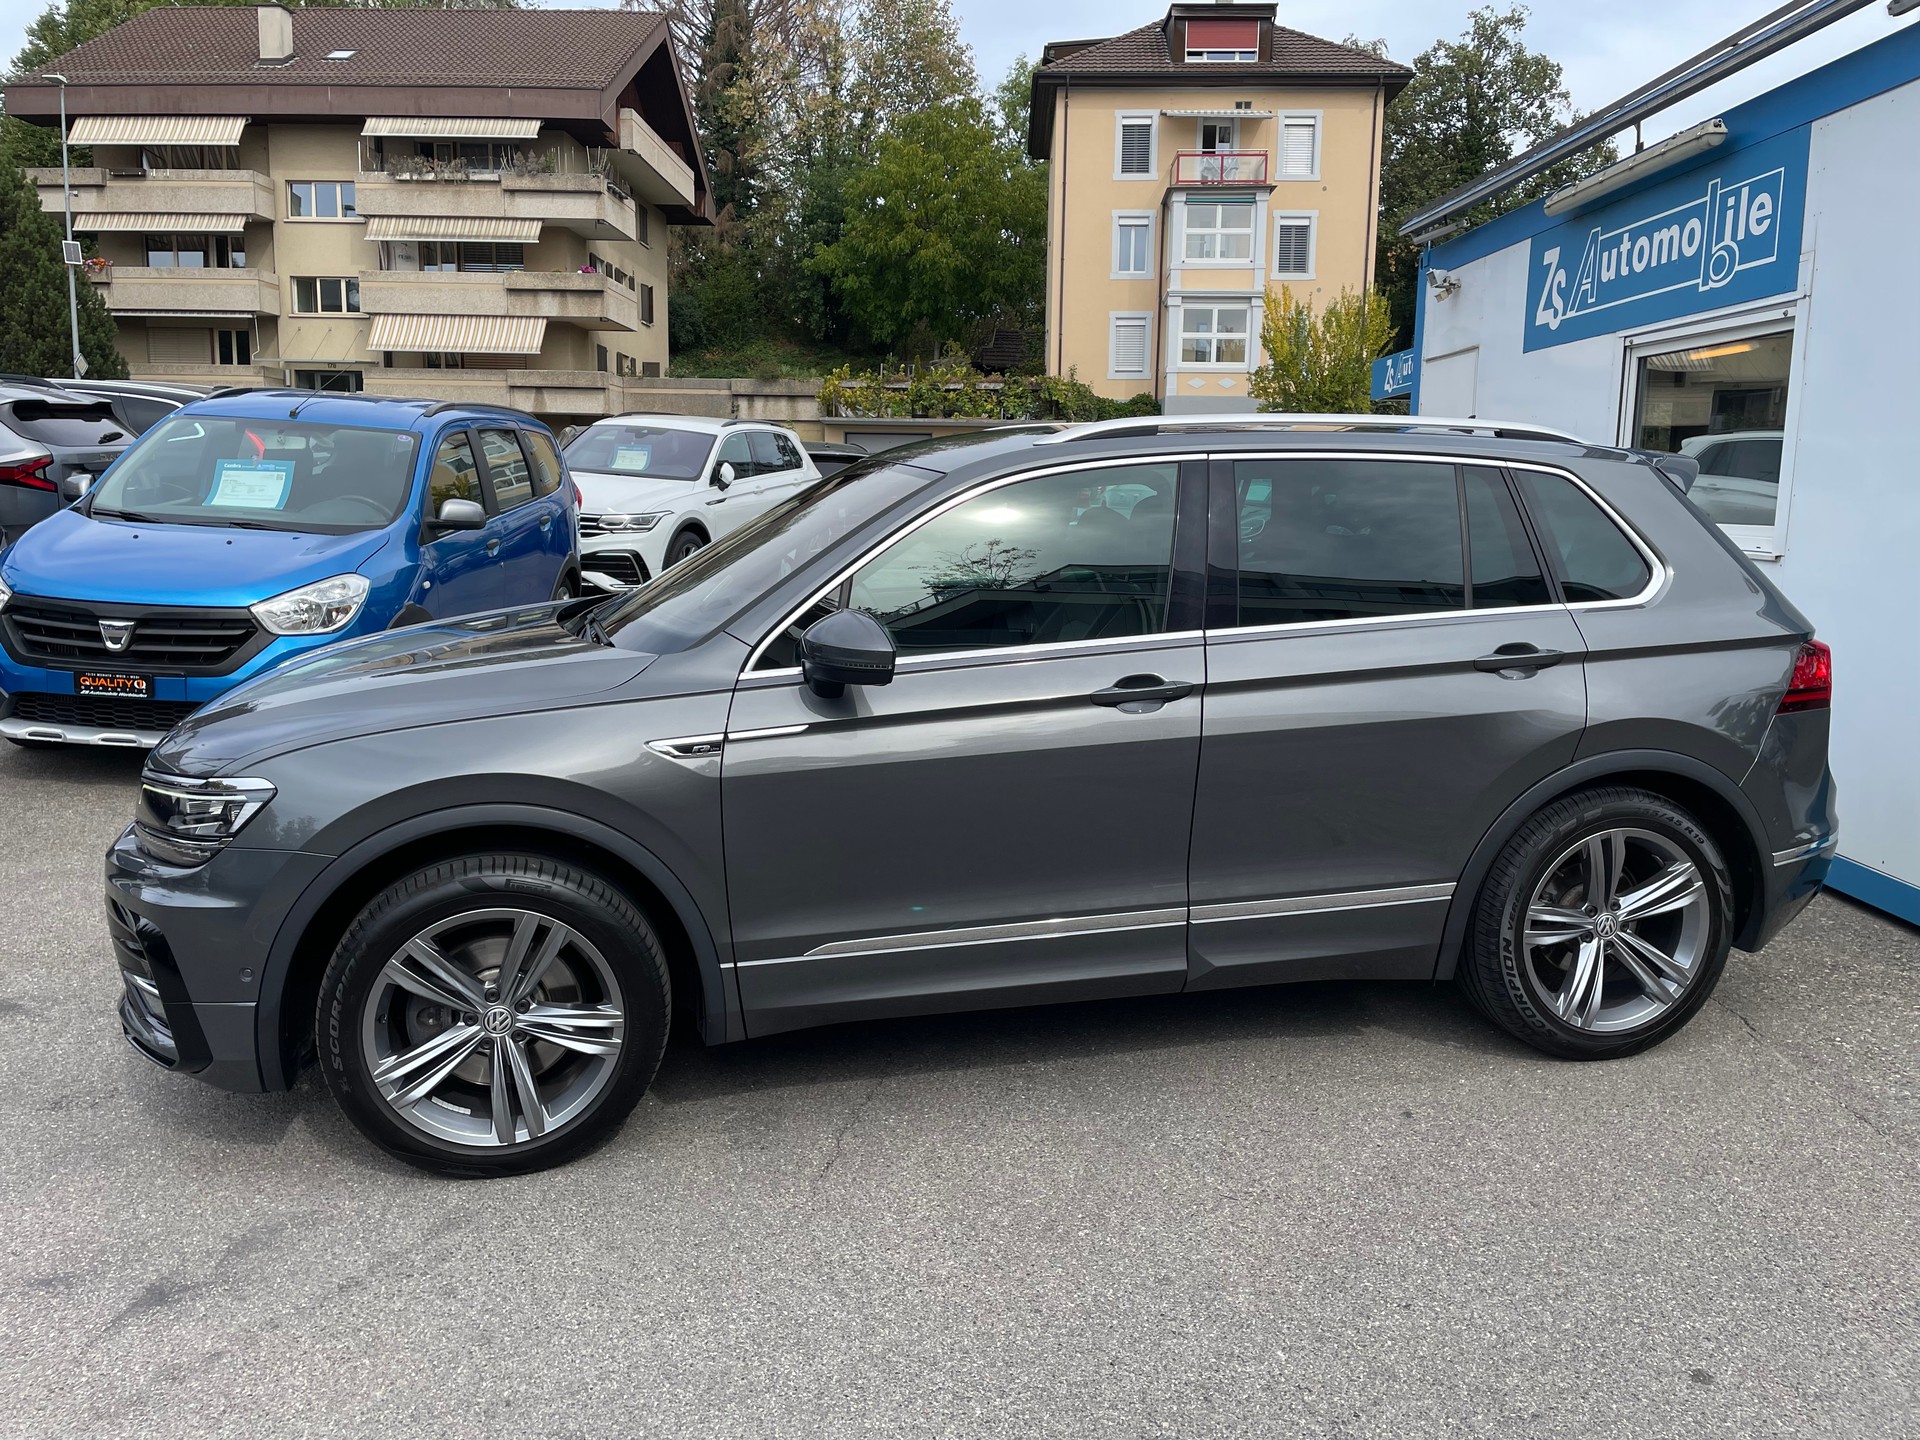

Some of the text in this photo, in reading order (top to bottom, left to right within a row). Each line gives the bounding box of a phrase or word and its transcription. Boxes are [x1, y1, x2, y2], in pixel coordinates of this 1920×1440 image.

[1567, 177, 1773, 314] Automobile
[80, 676, 133, 688] QUALITY
[1684, 825, 1705, 845] R19
